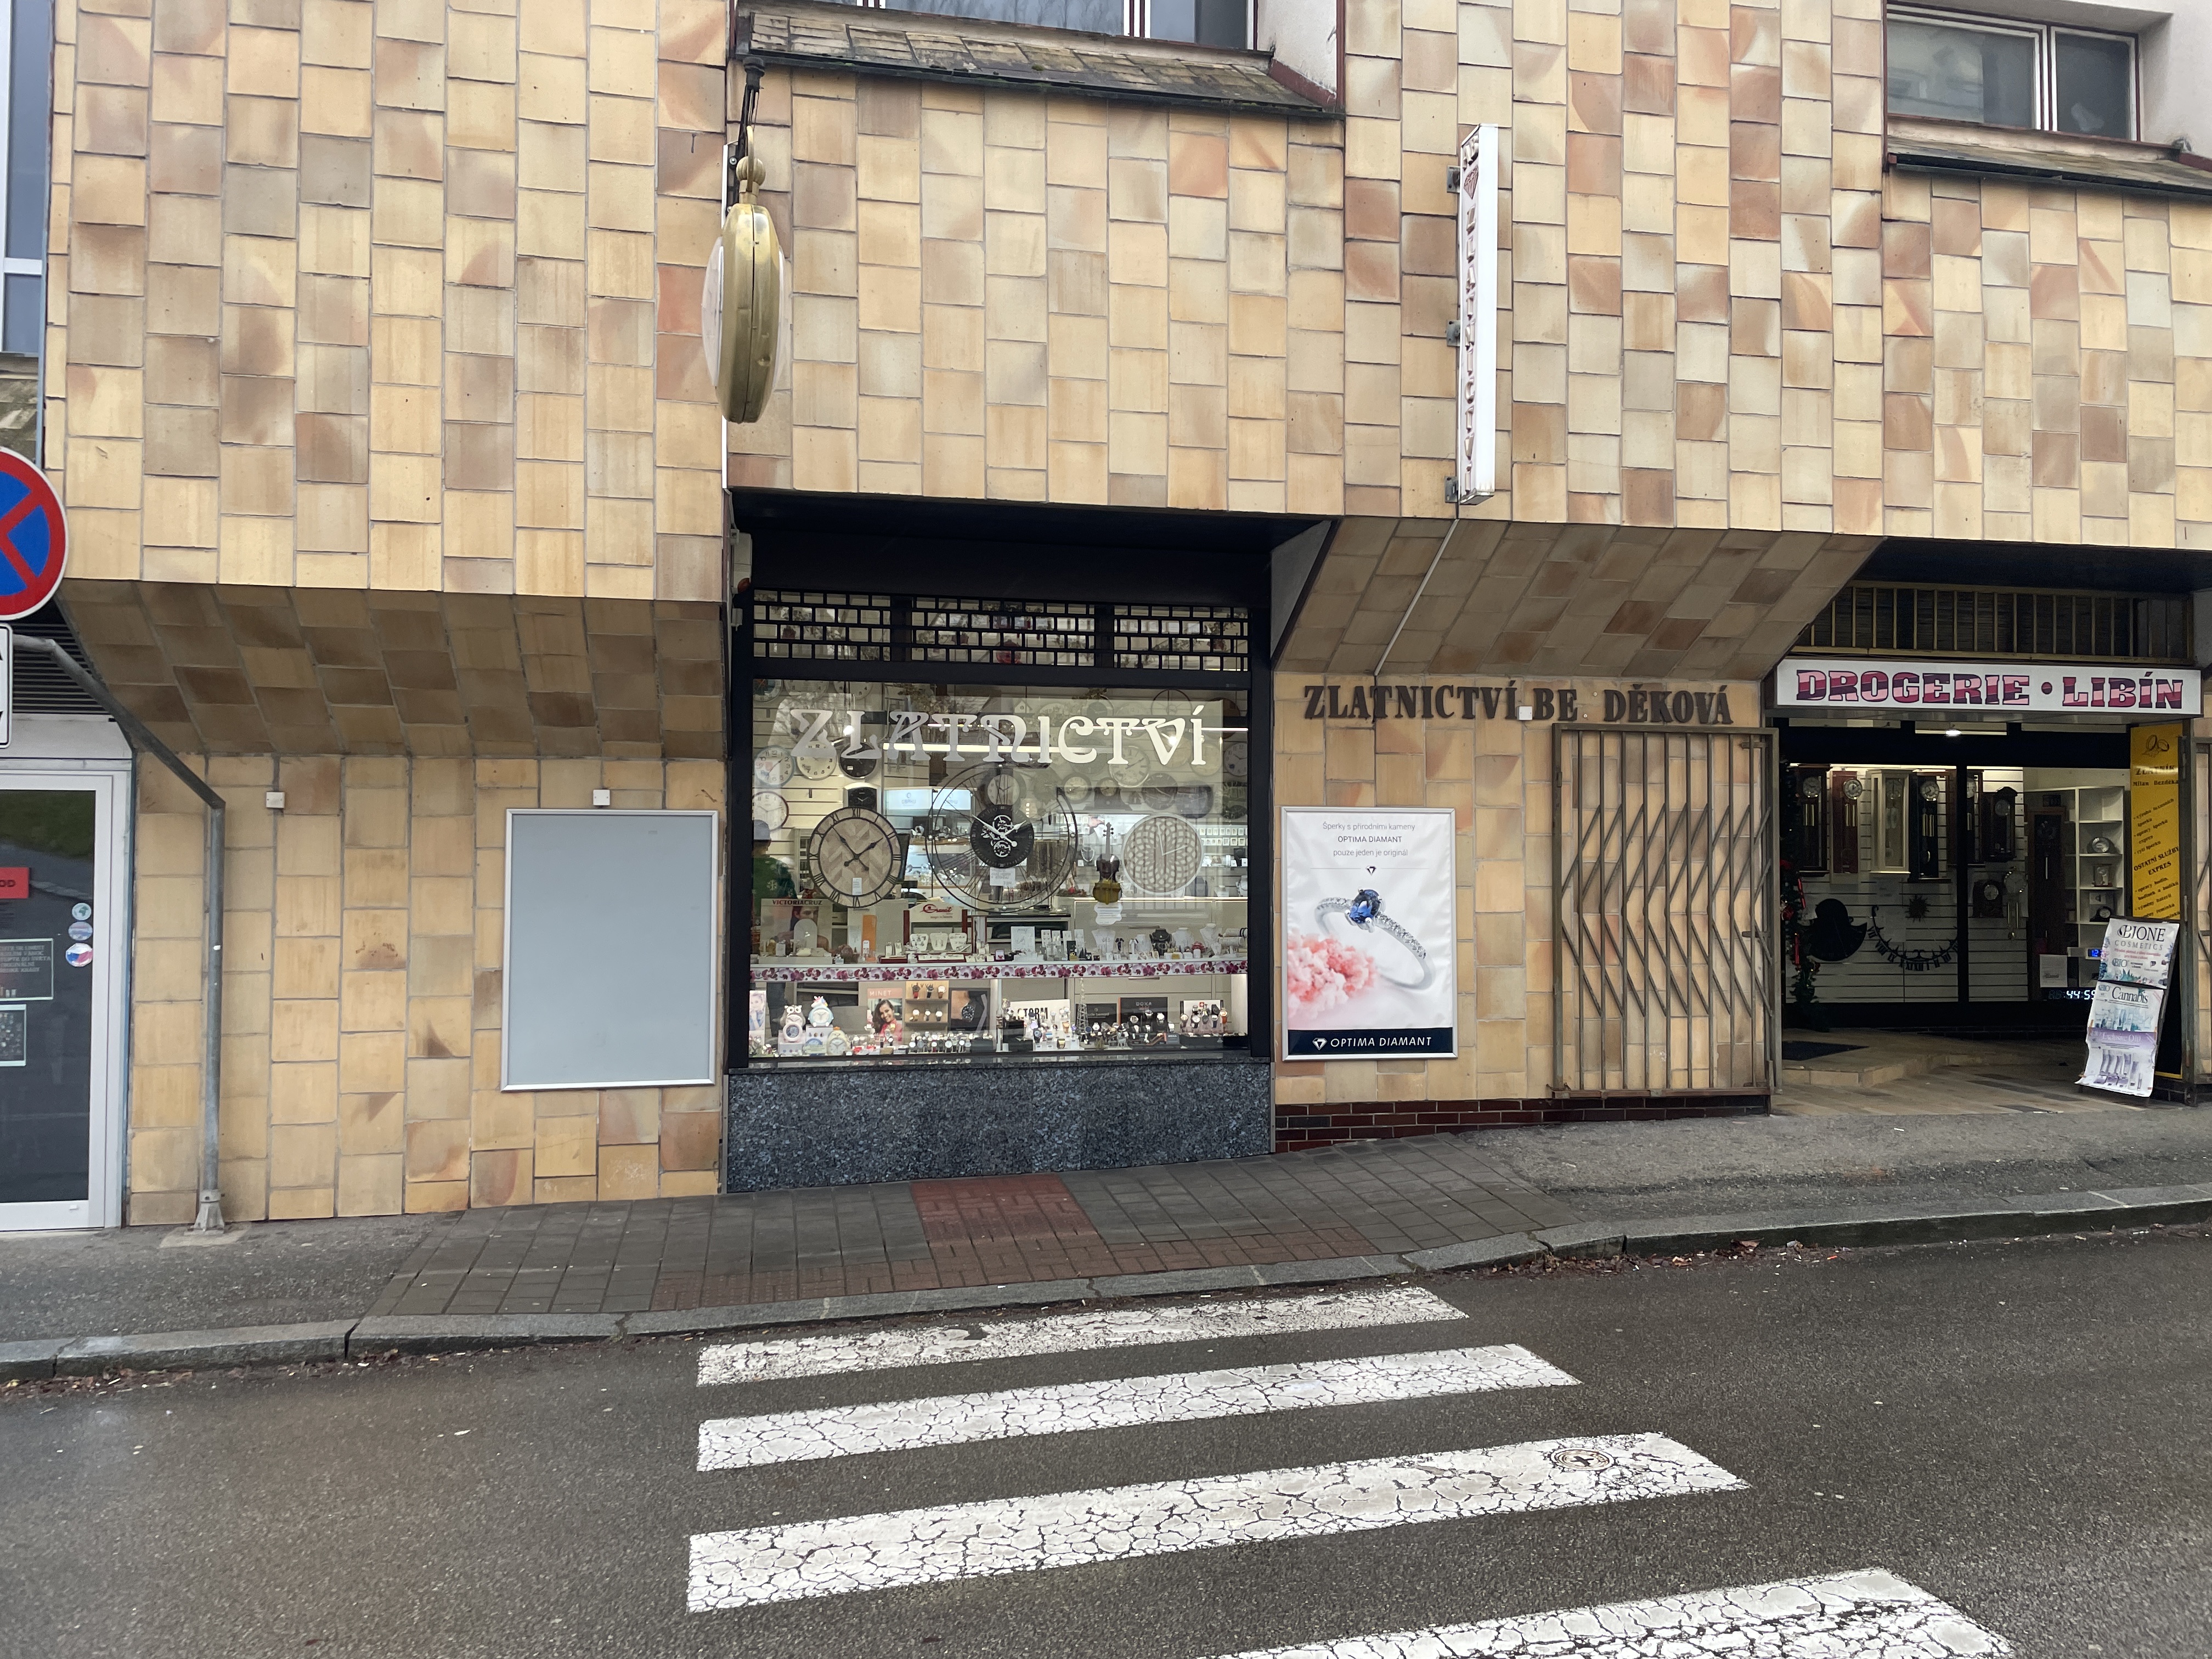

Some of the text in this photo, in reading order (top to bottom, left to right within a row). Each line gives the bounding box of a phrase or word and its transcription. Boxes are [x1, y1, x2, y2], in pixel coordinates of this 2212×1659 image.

[1796, 669, 2183, 709] DROGERIE LIBÍN
[1305, 680, 1734, 724] ZLATNICTVÍ BE DĚKOVÁ
[791, 705, 1206, 765] ZLATNICTVÍ
[1323, 821, 1345, 831] Šperky
[1353, 823, 1387, 831] přírodními
[1389, 823, 1415, 832] kameny
[1384, 849, 1408, 857] originál
[2134, 845, 2179, 871] OSTATNÍ SLUŽBY
[2148, 861, 2171, 875] EXPRES
[2117, 924, 2166, 942] BIONE
[2114, 940, 2163, 951] COSMETICS
[2112, 986, 2149, 1004] Cannabis
[1330, 1037, 1432, 1047] OPTIMA DIAMANT
